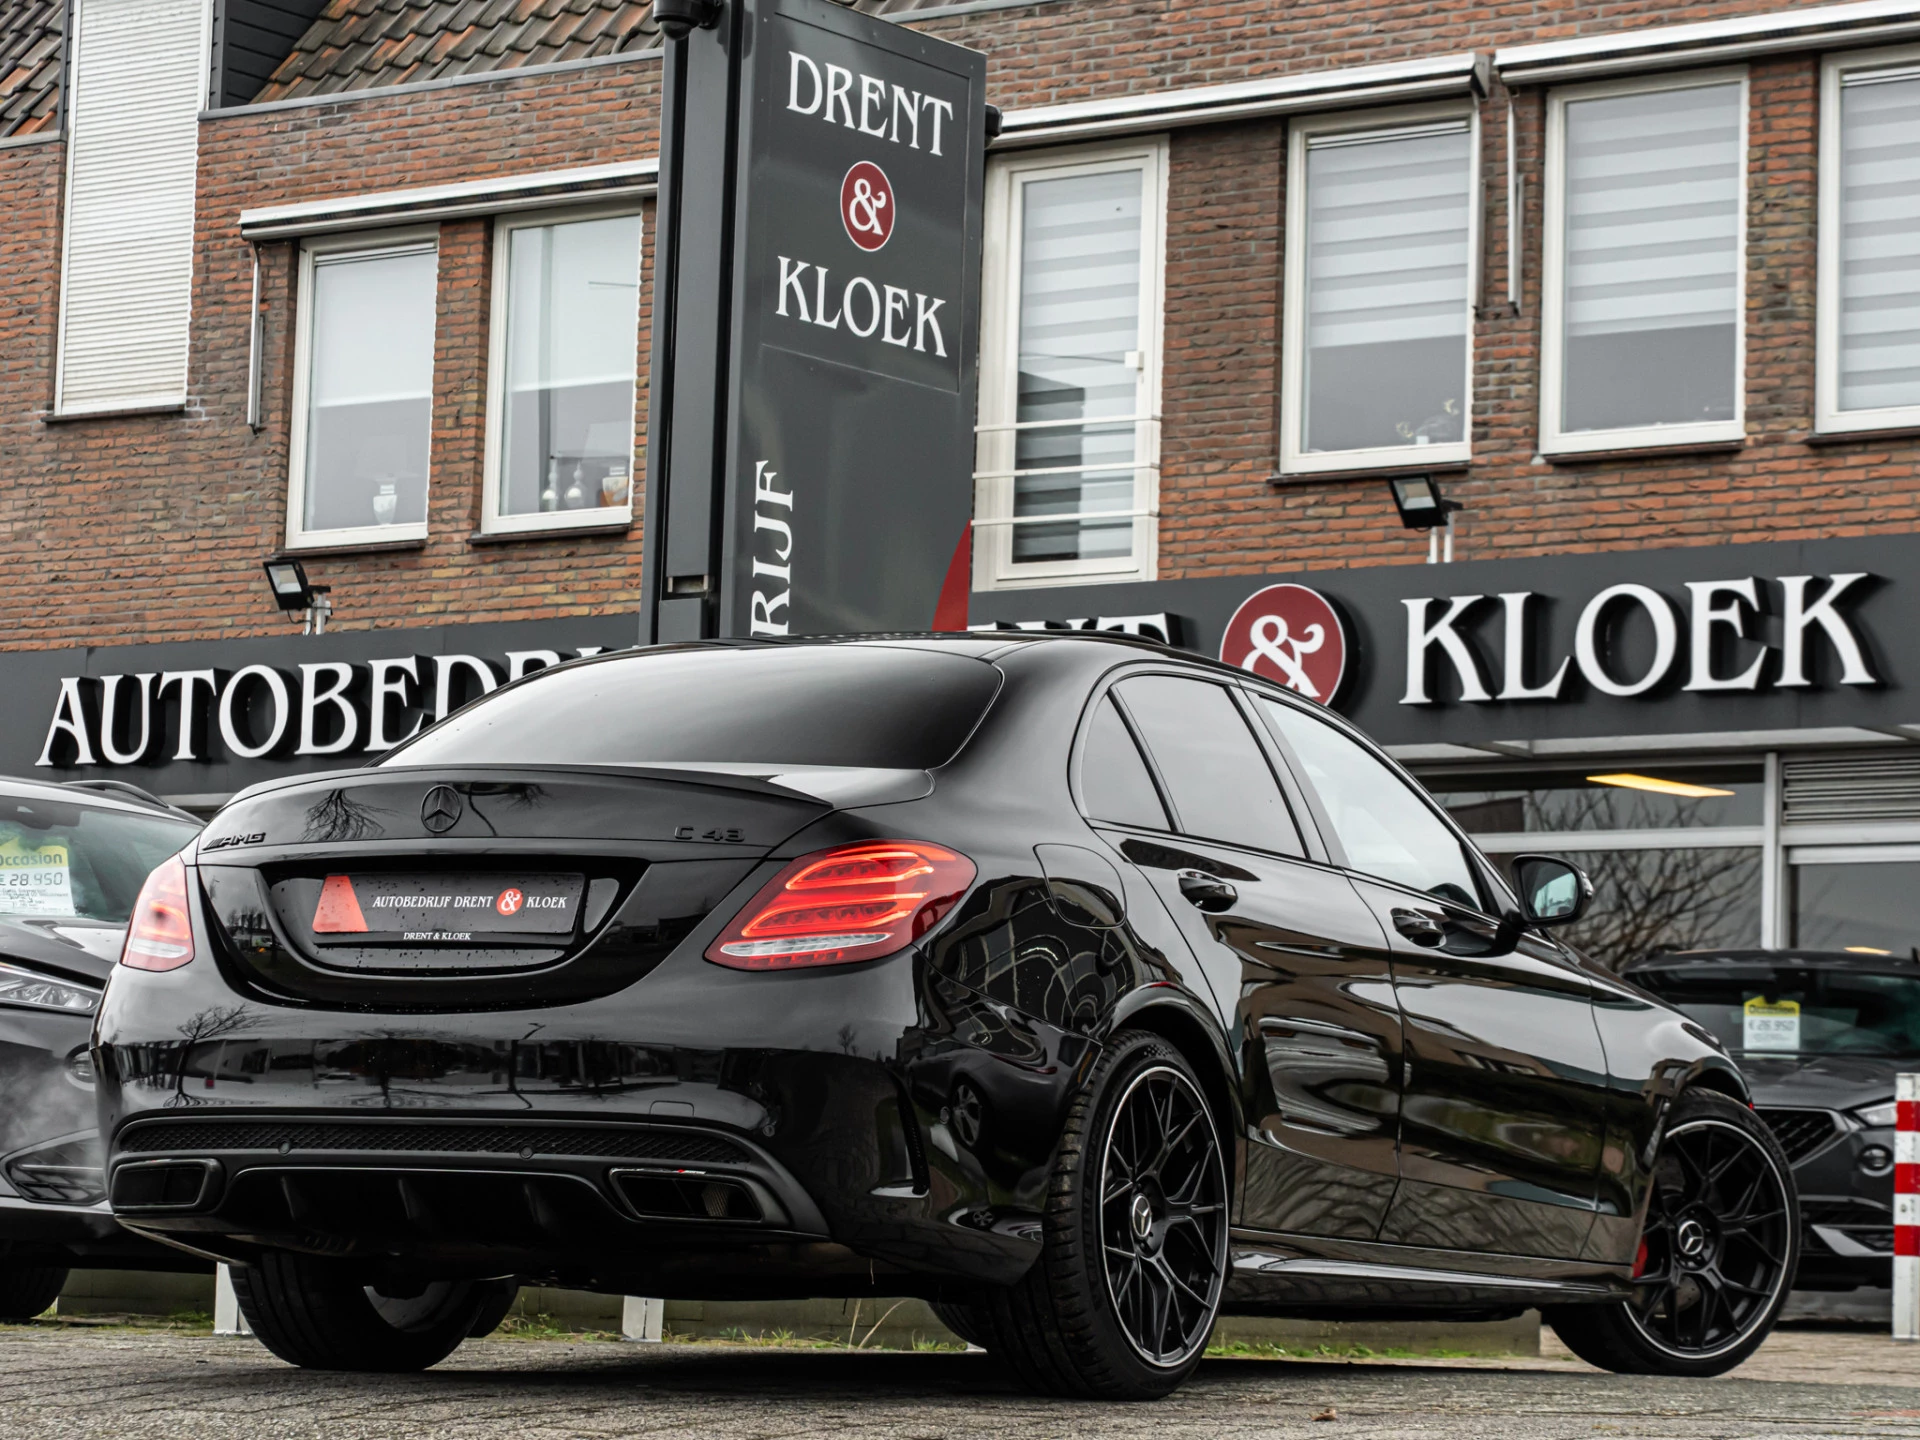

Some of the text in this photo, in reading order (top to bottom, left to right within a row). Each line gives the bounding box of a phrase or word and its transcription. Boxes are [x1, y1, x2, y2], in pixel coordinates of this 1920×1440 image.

[786, 51, 954, 157] DRENT
[849, 178, 887, 236] &
[775, 256, 948, 358] KLOEK
[1242, 571, 1877, 706] & KLOEK
[219, 832, 266, 848] AMG
[702, 827, 745, 842] 43
[9, 872, 63, 886] 28.950
[372, 890, 568, 911] AUTOBEDRIJF DRENT & KLOEK
[403, 932, 472, 940] DRENT & KLOEK
